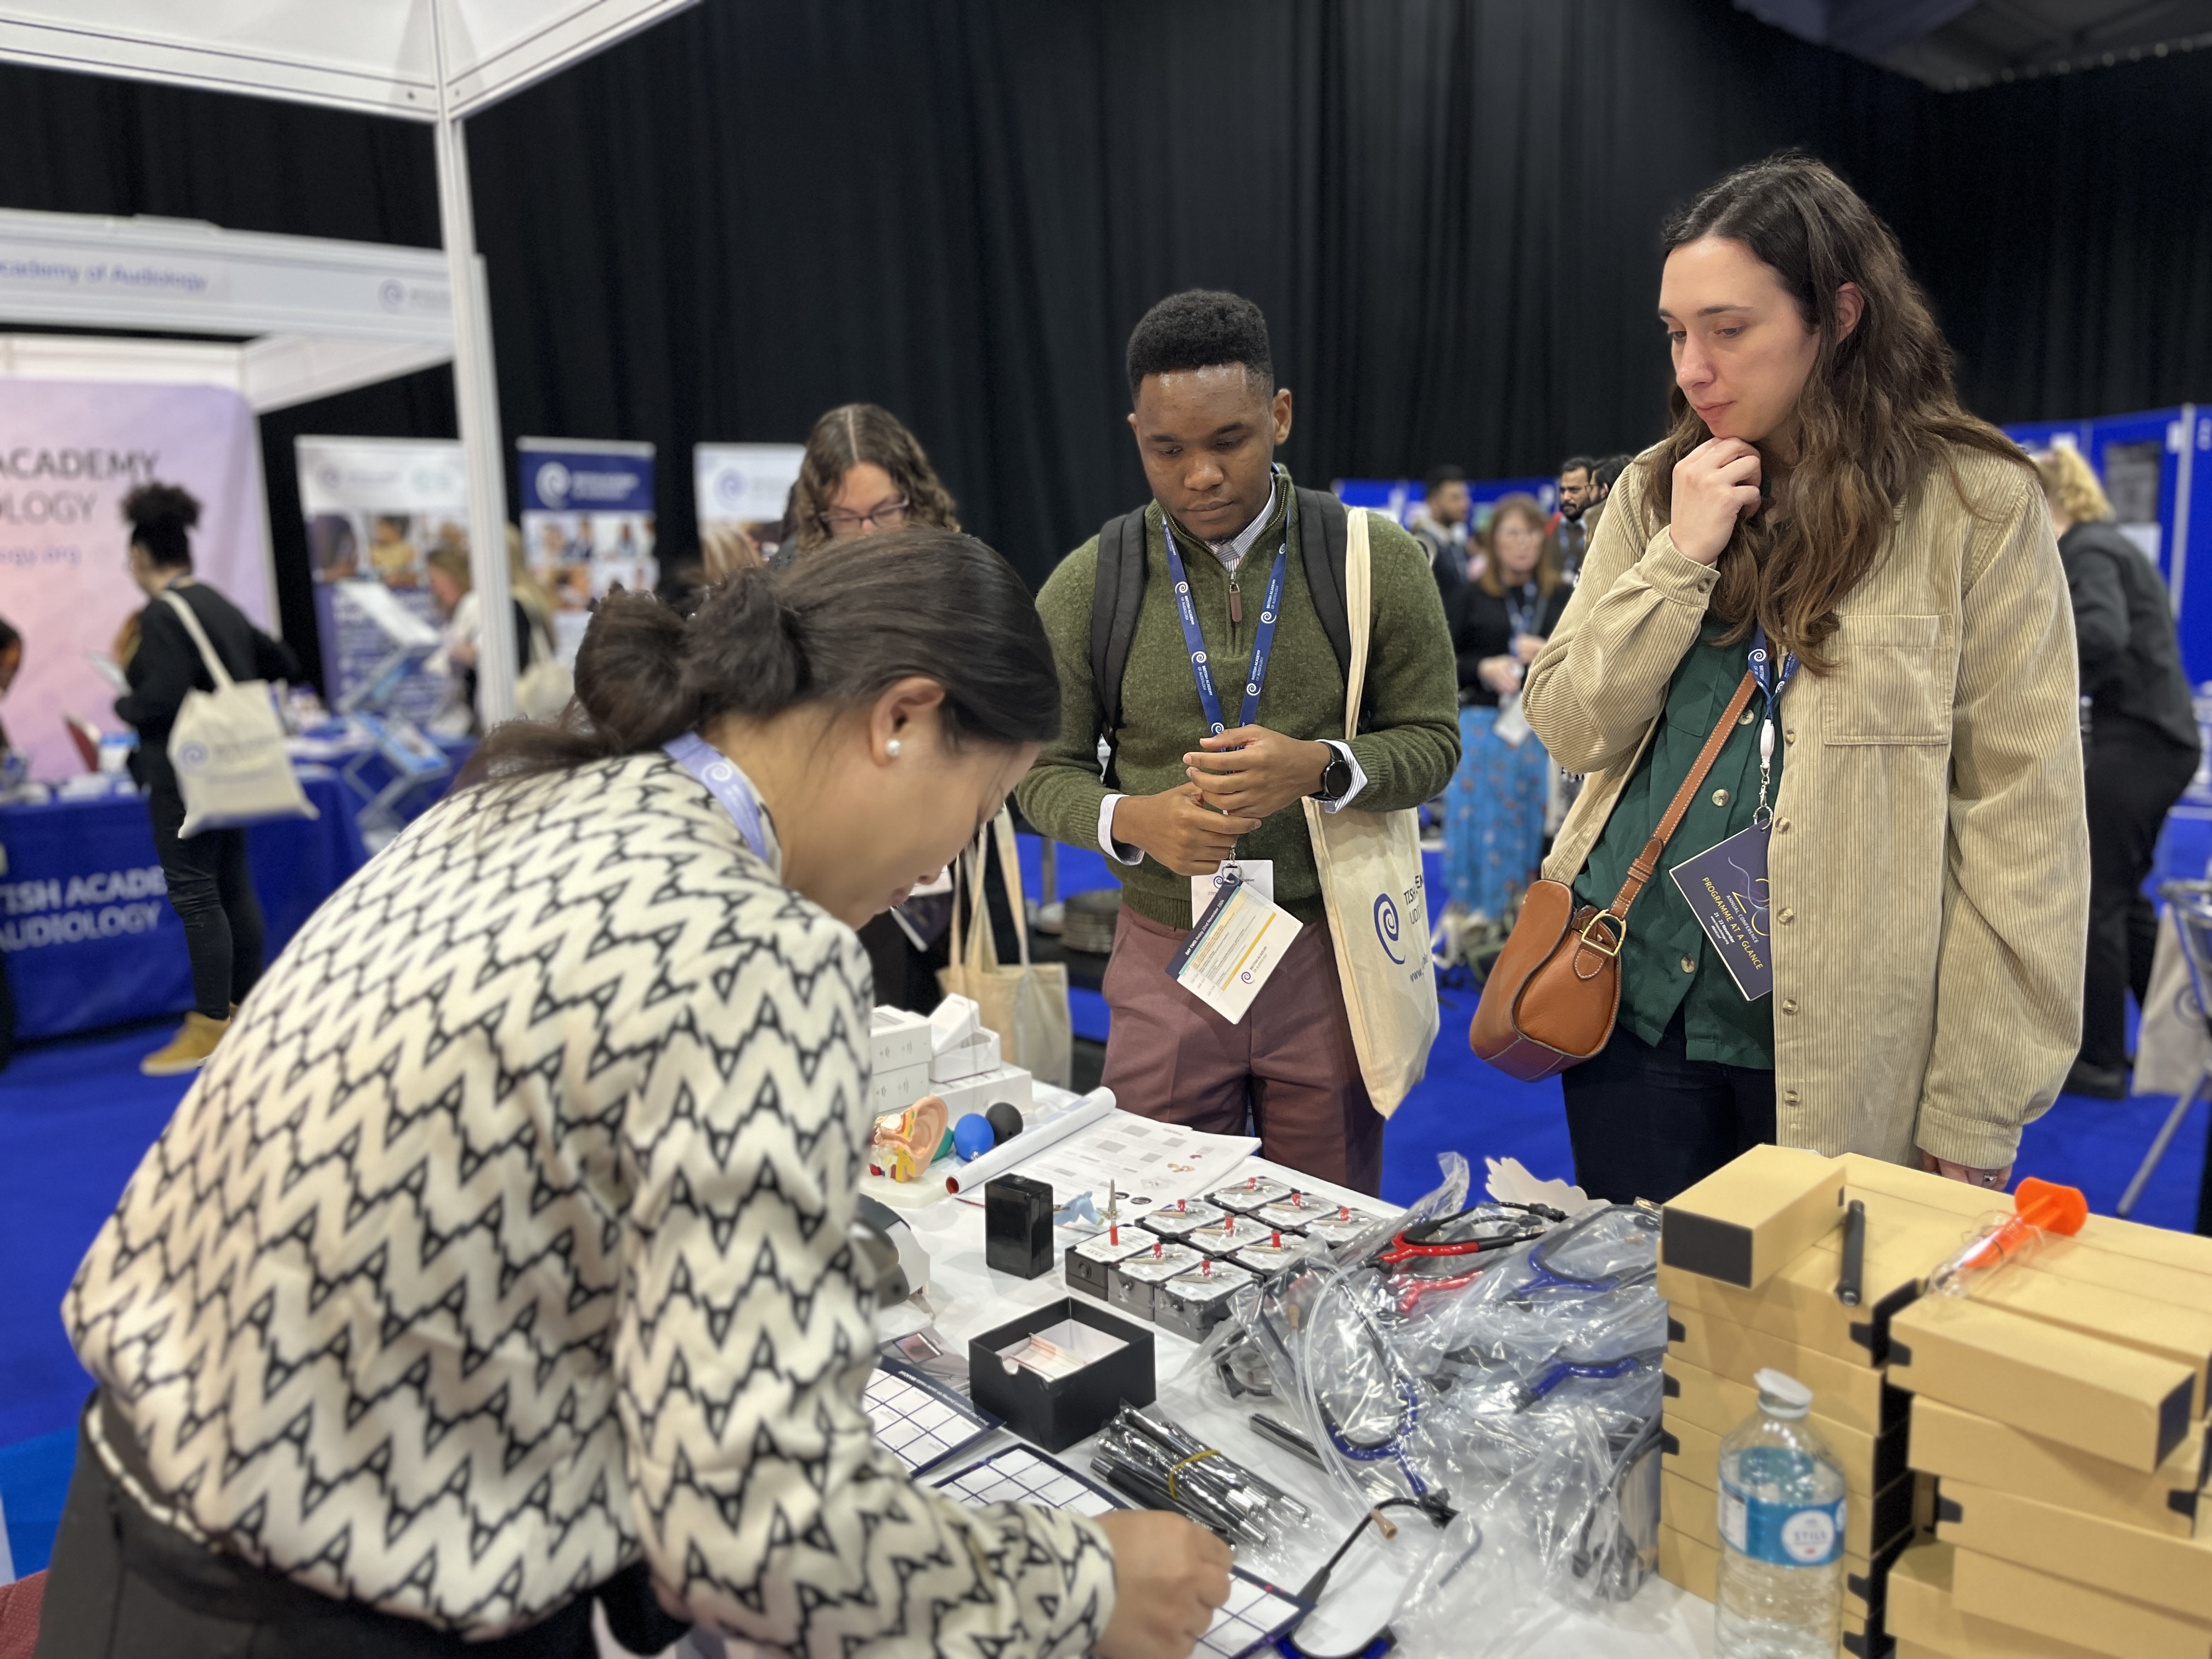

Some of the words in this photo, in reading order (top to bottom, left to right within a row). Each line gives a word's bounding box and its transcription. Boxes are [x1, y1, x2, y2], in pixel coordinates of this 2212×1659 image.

[111, 262, 208, 294] Audiology
[1195, 930, 1204, 940] Friday
[1207, 907, 1218, 923] November
[1702, 877, 1734, 922] PROGRAMME
[1730, 923, 1741, 932] AT
[1741, 940, 1763, 970] GLANCE
[1722, 924, 1735, 943] November
[1726, 895, 1740, 913] ANNUAL
[1738, 914, 1759, 943] CONFERENCE
[1257, 946, 1267, 959] ACADEMY
[1794, 1531, 1827, 1541] STILL
